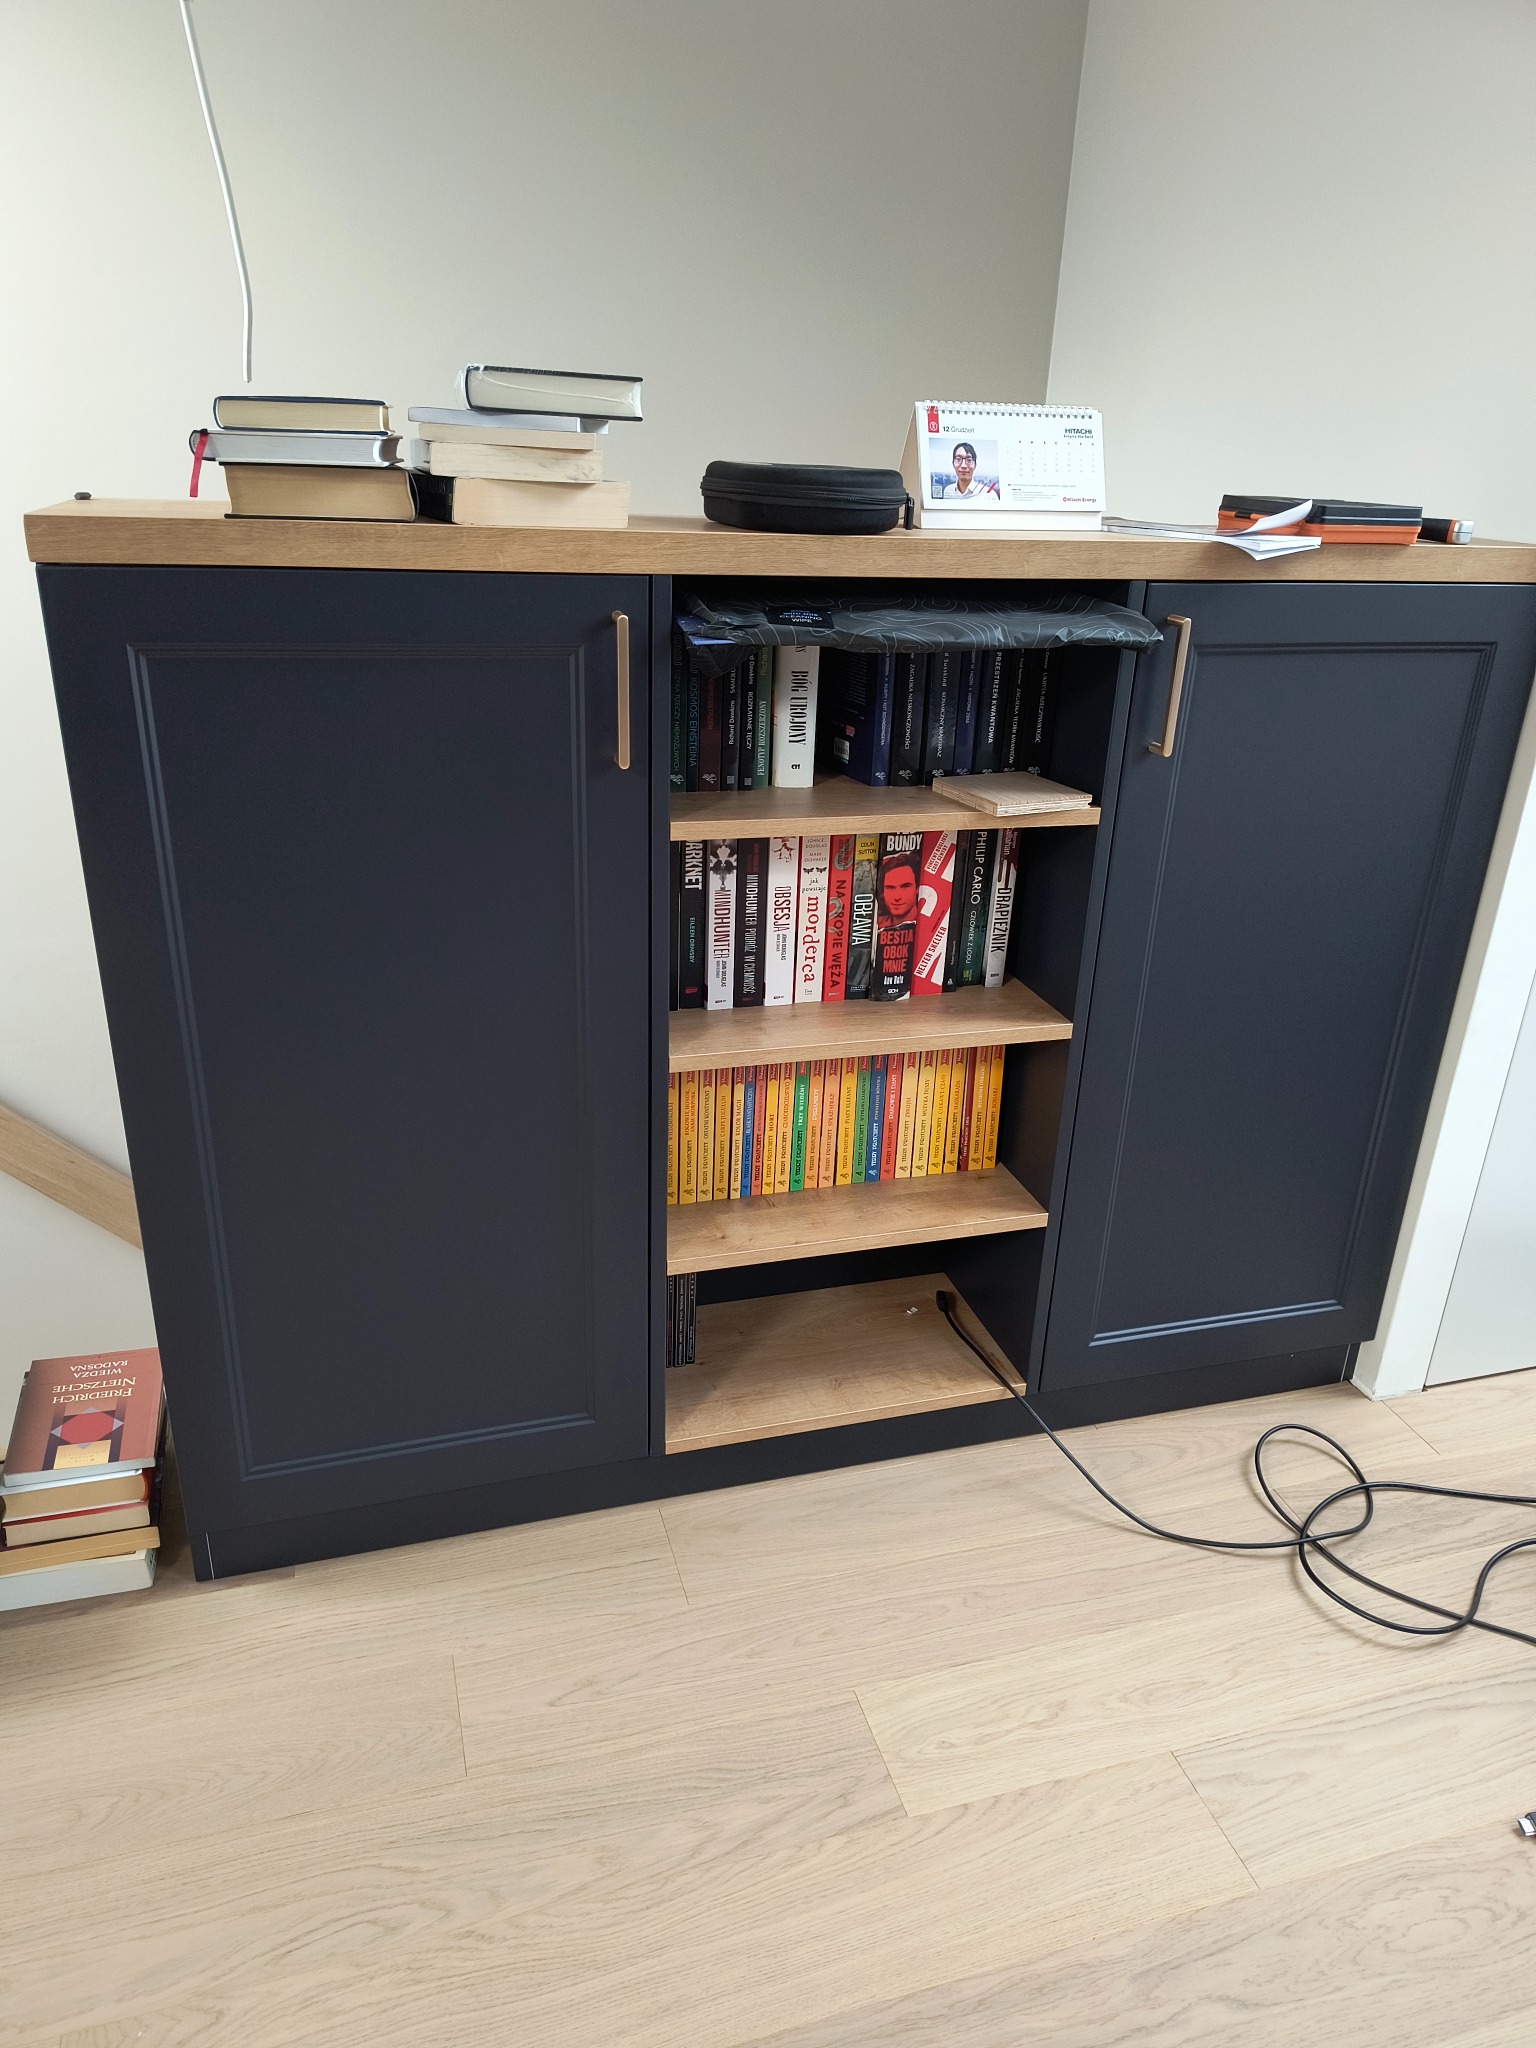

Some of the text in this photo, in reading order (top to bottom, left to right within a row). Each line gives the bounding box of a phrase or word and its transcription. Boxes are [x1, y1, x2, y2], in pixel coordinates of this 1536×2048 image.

[690, 677, 698, 717] KOSMOS
[791, 671, 812, 692] BÓG
[987, 652, 1003, 743] PRZESTRZEŃ KWANTOWA
[1014, 688, 1022, 714] ZAGADKA
[757, 700, 767, 775] FENOTYP ROZSZERZONY
[788, 697, 808, 746] UROJONY
[689, 720, 697, 767] EINSTEINA
[1008, 734, 1016, 764] KWANTÓW
[886, 834, 923, 851] BUNDY
[974, 831, 987, 863] PHILIP
[684, 840, 702, 890] ARKNET
[745, 874, 759, 926] MINDHUNTER
[835, 880, 846, 898] NA
[970, 866, 983, 904] CARLO
[713, 889, 731, 959] MINDHUNTER
[773, 886, 792, 932] OBSESJA
[851, 893, 874, 946] OBŁAWA
[991, 887, 1012, 953] DRAPIEŻNIK
[744, 928, 758, 953] PODRÓŻ
[802, 896, 820, 983] morderca
[880, 929, 913, 945] BESTIA
[968, 911, 977, 941] CZŁOWIEK
[883, 946, 908, 959] OBOK
[883, 959, 907, 974] MNIE
[915, 946, 934, 976] HELTER
[931, 926, 947, 953] SKELTER
[743, 963, 756, 994] CIEMNOŚĆ
[829, 953, 843, 988] WĘŻA
[70, 1360, 128, 1371] RADOSNA
[73, 1368, 122, 1378] WIEDZA
[52, 1377, 136, 1393] NIETZSCHE
[52, 1387, 133, 1404] FRIEDRICH
